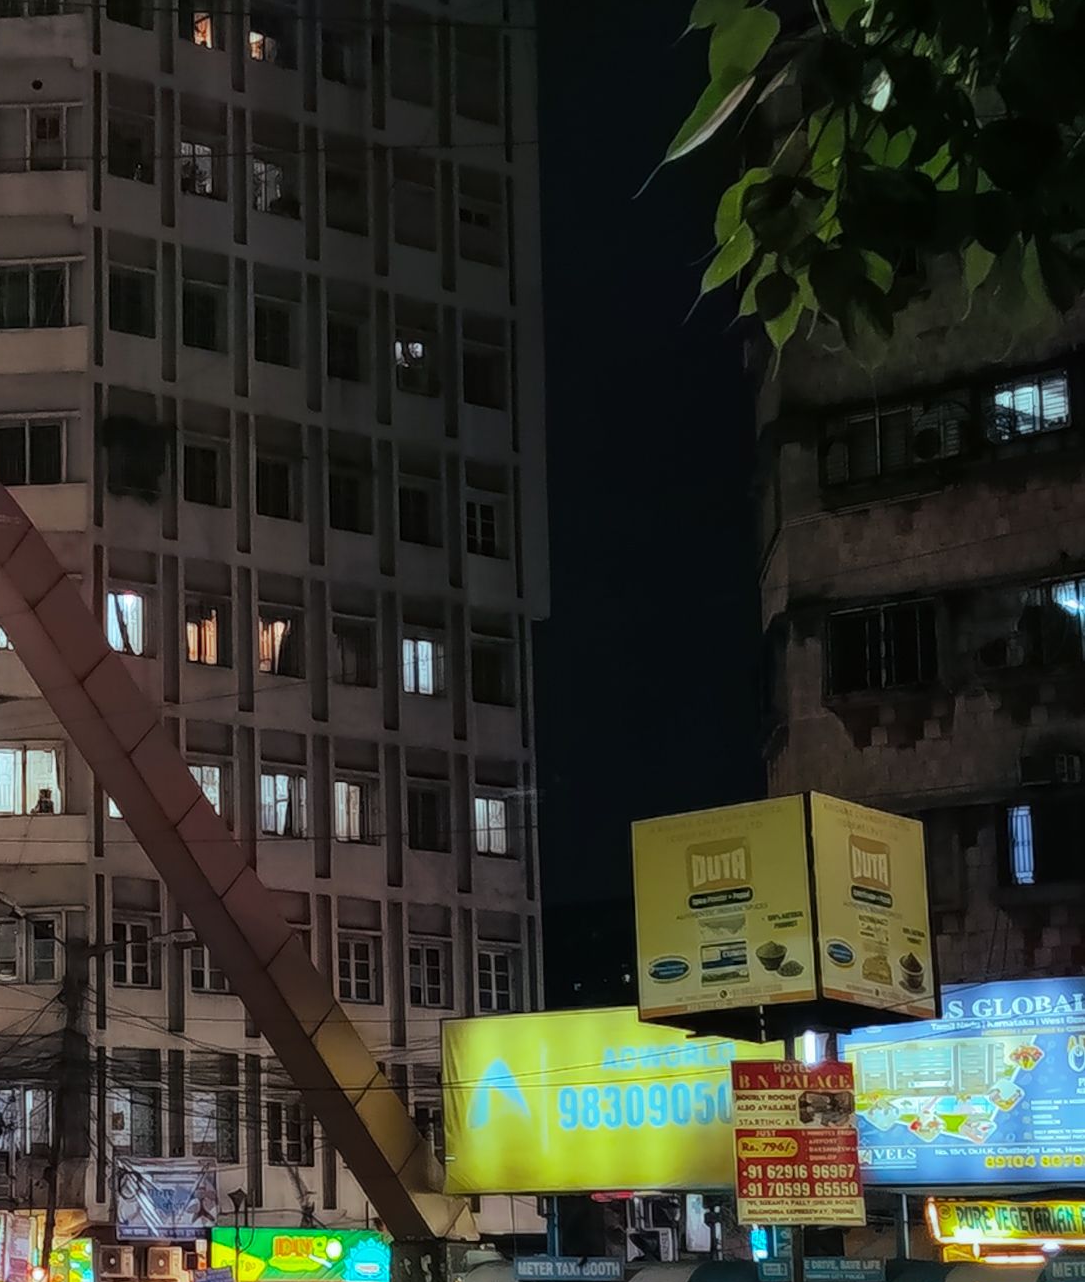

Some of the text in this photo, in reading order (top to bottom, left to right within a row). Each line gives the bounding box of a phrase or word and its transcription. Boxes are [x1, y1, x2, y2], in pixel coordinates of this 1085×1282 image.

[691, 847, 746, 888] DUTA
[851, 844, 889, 886] DUTA
[972, 993, 1085, 1018] GLOBAL
[773, 1063, 811, 1073] HOTEL
[739, 1074, 750, 1088] B
[780, 1074, 851, 1088] PALACE
[741, 1141, 795, 1152] Rs. 796/-
[767, 1164, 808, 1179] 62916
[812, 1164, 855, 1179] 96967
[767, 1182, 810, 1196] 70599
[815, 1181, 858, 1196] 65550
[955, 1206, 992, 1230] PURE
[995, 1206, 1077, 1234] VEGETARIAN
[518, 1261, 620, 1276] METER TAXI BOOTH
[863, 1260, 881, 1270] LIFE
